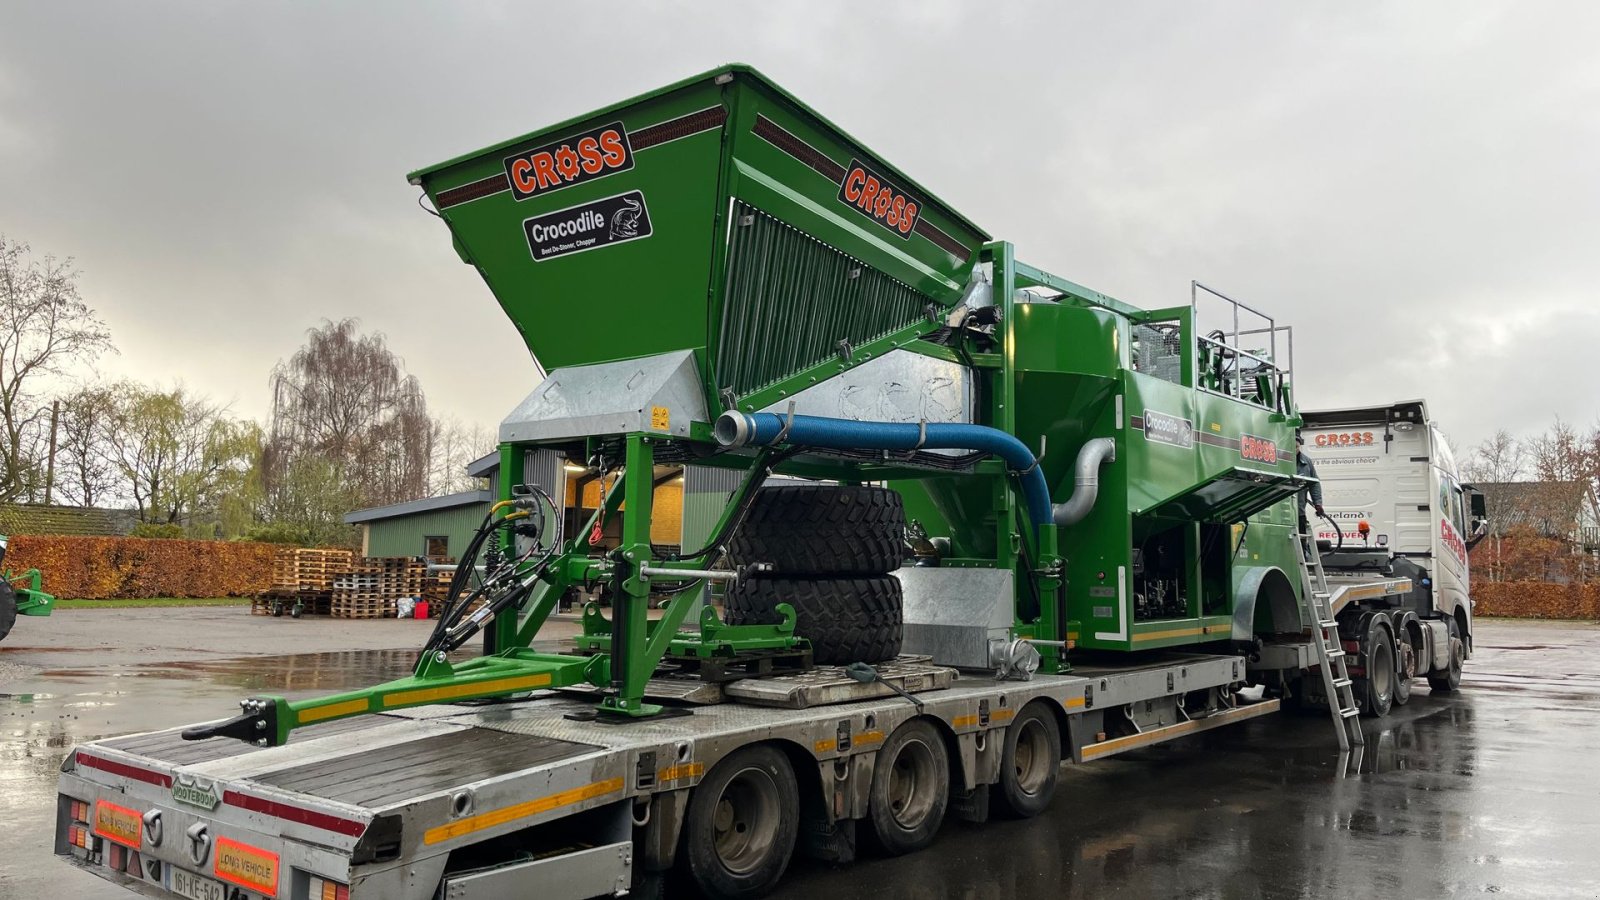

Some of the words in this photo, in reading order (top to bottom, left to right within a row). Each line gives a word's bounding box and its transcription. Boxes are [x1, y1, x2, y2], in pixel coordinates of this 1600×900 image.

[511, 129, 626, 194] CROSS
[844, 167, 917, 233] CROSS
[532, 210, 605, 243] Crocodile
[576, 236, 597, 247] Chopper
[1146, 412, 1178, 434] Crocodile
[1241, 435, 1276, 463] CROSS
[1314, 432, 1374, 447] CROSS
[1331, 457, 1355, 465] obvious
[173, 785, 215, 808] NOOTEBOOM
[220, 852, 241, 869] LONG
[241, 857, 272, 879] VEHICLE
[174, 871, 220, 900] 161-KE-542
